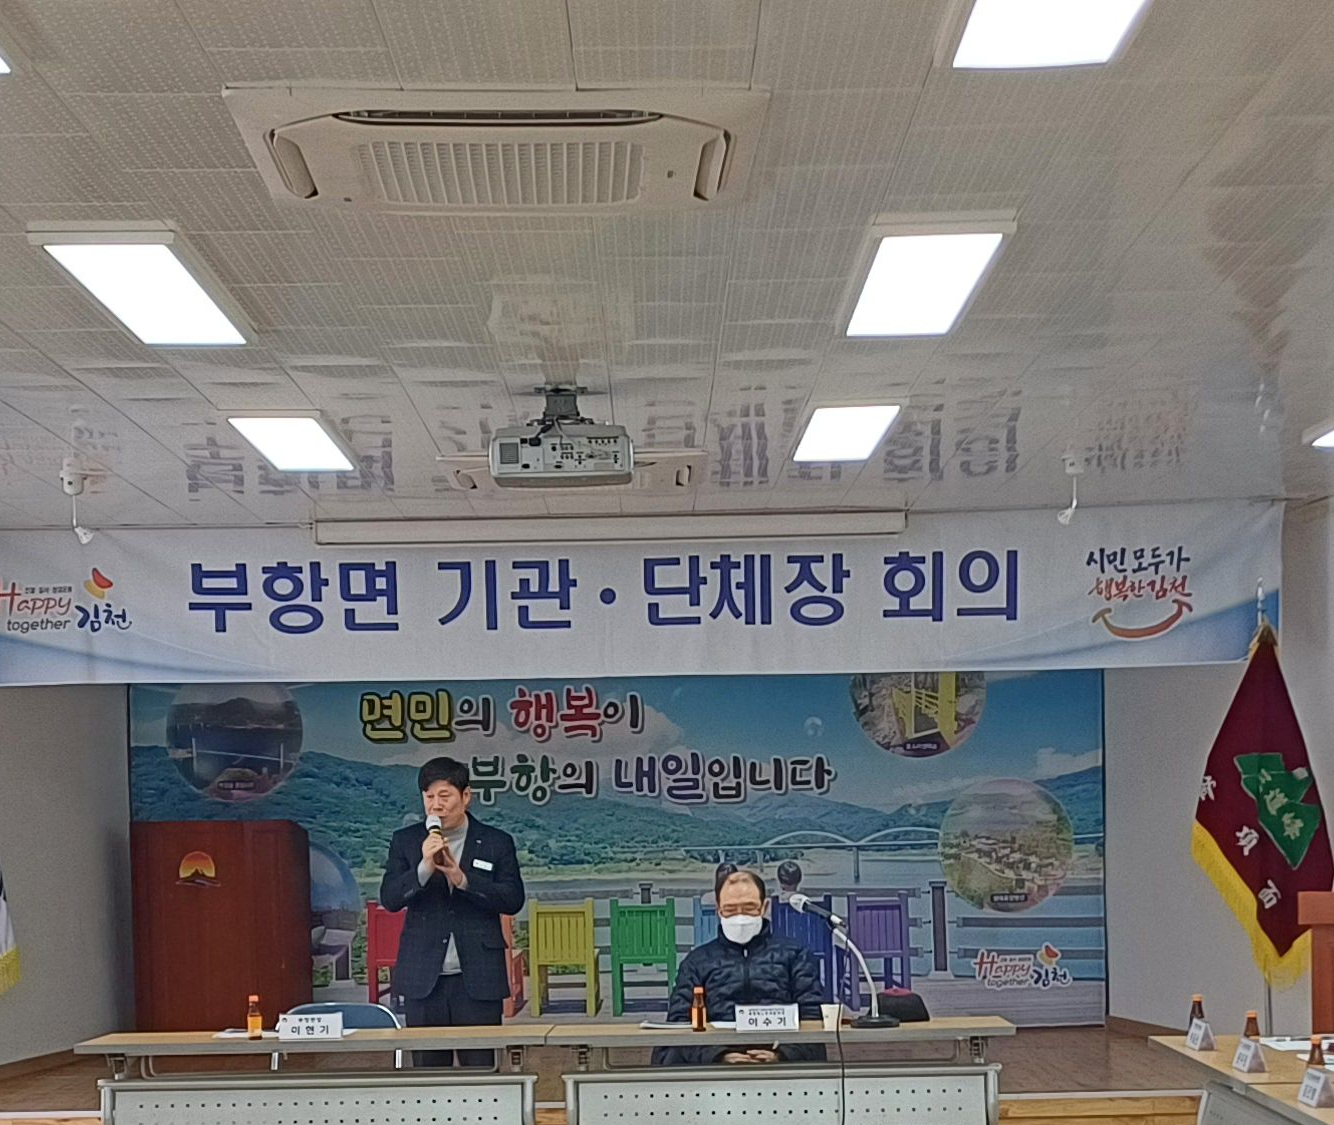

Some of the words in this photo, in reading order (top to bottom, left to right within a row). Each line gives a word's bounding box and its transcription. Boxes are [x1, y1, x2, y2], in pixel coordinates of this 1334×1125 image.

[1086, 547, 1127, 574] 시민
[1132, 546, 1191, 575] 모두가
[188, 560, 399, 634] 부항면
[881, 549, 1019, 623] 회의
[1088, 575, 1145, 601] 행복한
[1147, 575, 1192, 600] 김천
[7, 617, 71, 633] together
[75, 603, 132, 632] 김천
[361, 689, 495, 742] 면민의
[511, 686, 642, 740] 행복이
[468, 754, 595, 802] 부항의
[614, 752, 833, 802] 내일입니다
[973, 951, 1031, 979] Happy
[1033, 967, 1070, 987] 김천
